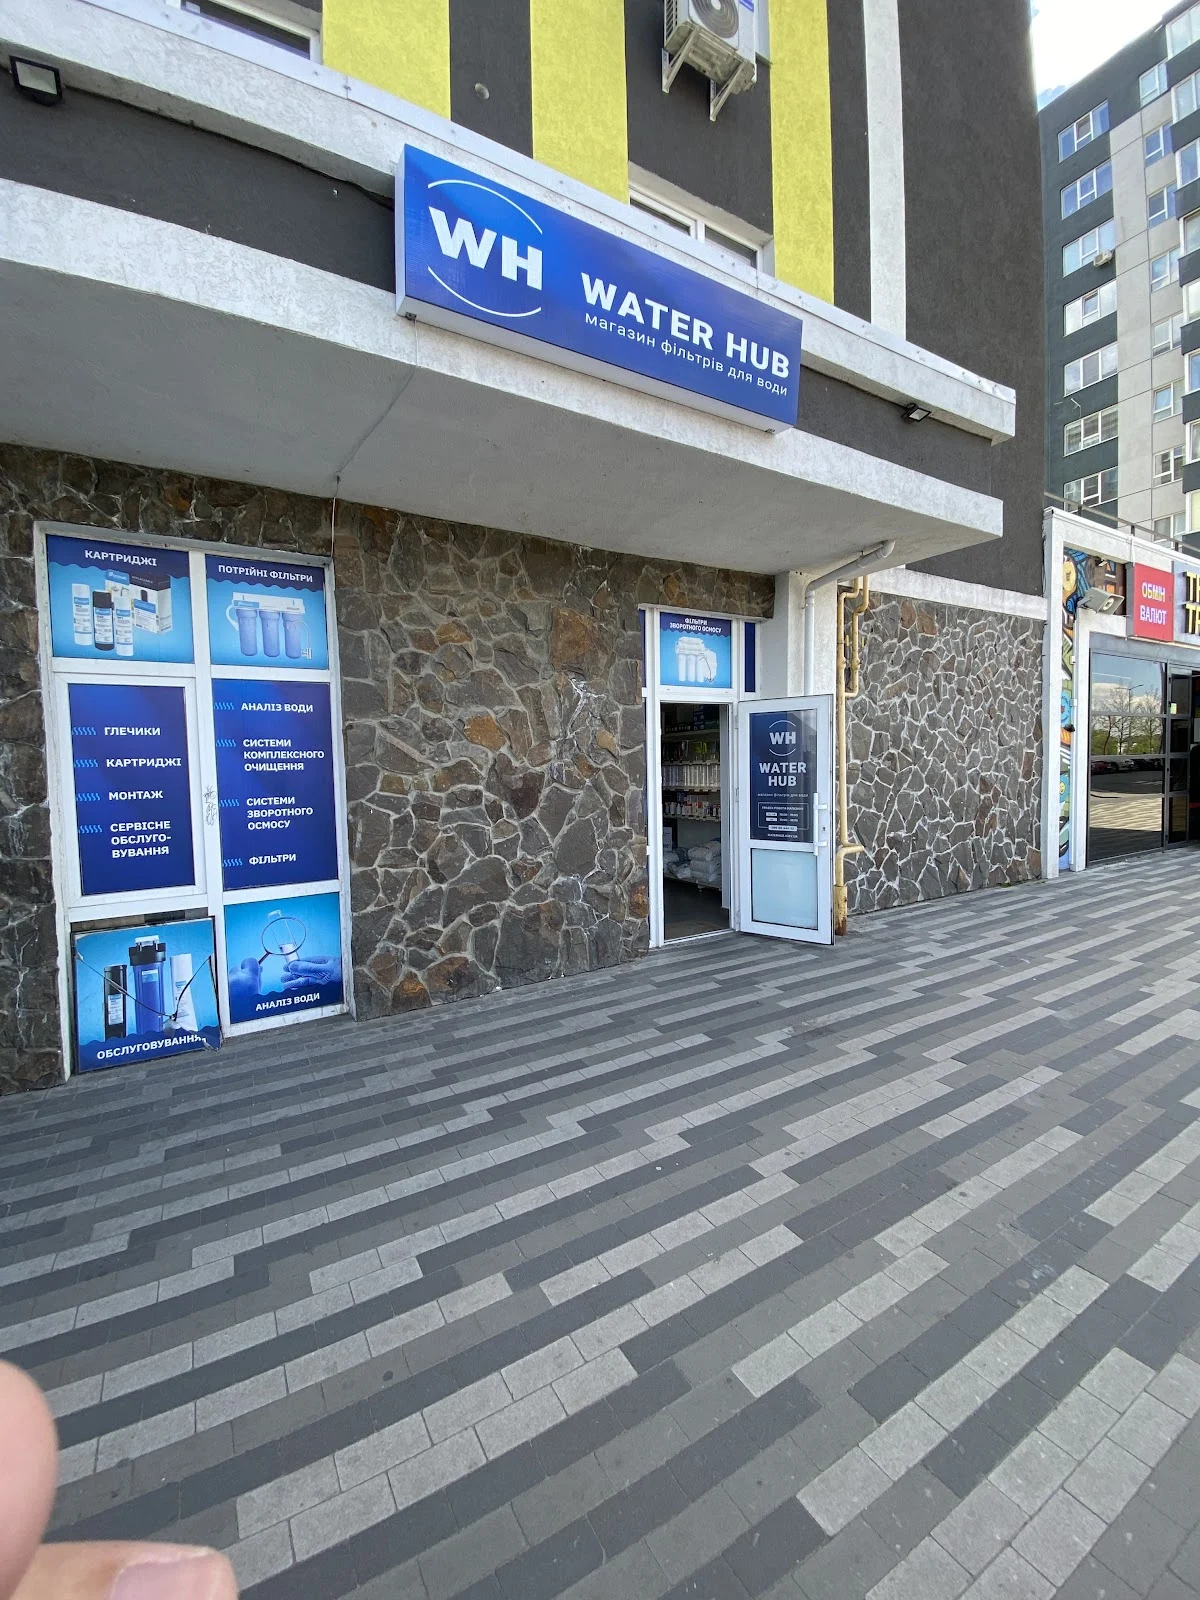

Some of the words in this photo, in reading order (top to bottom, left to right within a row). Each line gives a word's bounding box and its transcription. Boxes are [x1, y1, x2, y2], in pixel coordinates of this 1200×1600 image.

[428, 206, 542, 291] WH
[581, 272, 714, 351] WATER
[726, 332, 789, 379] HUB
[585, 313, 656, 347] магазин
[661, 339, 724, 375] фільтрів
[728, 367, 753, 384] для
[757, 378, 788, 396] води
[85, 549, 157, 567] КАРТРИДЖІ
[218, 564, 268, 579] ПОТРІЙНІ
[269, 569, 313, 583] ФІЛЬТРИ
[1142, 581, 1166, 603] ОБМІН
[1140, 604, 1167, 625] ВАЛЮТ
[684, 617, 708, 625] ФІЛЬТРИ
[669, 622, 702, 631] ЗВОРОТНОГО
[702, 626, 722, 634] ОСМОСУ
[241, 703, 282, 712] АНАЛІЗ
[284, 703, 314, 713] ВОДИ
[104, 727, 161, 736] ГЛЕЧИКИ
[243, 739, 291, 747] СИСТЕМИ
[769, 731, 796, 745] WH
[243, 750, 325, 759] КОМПЛЕКСНОГО
[106, 757, 182, 768] КАРТРИДЖІ
[244, 762, 304, 772] ОЧИЩЕННЯ
[759, 762, 807, 774] WATER
[768, 775, 797, 787] HUB
[108, 790, 163, 801] МОНТАЖ
[246, 796, 296, 807] СИСТЕМИ
[247, 807, 313, 818] ЗВОРОТНОГО
[110, 820, 171, 832] СЕРВІСНЕ
[248, 819, 291, 831] ОСМОСУ
[111, 833, 172, 845] ОБСЛУГО-
[112, 846, 169, 859] ВУВАННЯ
[249, 853, 296, 866] ФІЛЬТРИ
[255, 995, 292, 1012] АНАЛІЗ
[293, 992, 320, 1006] ВОДИ
